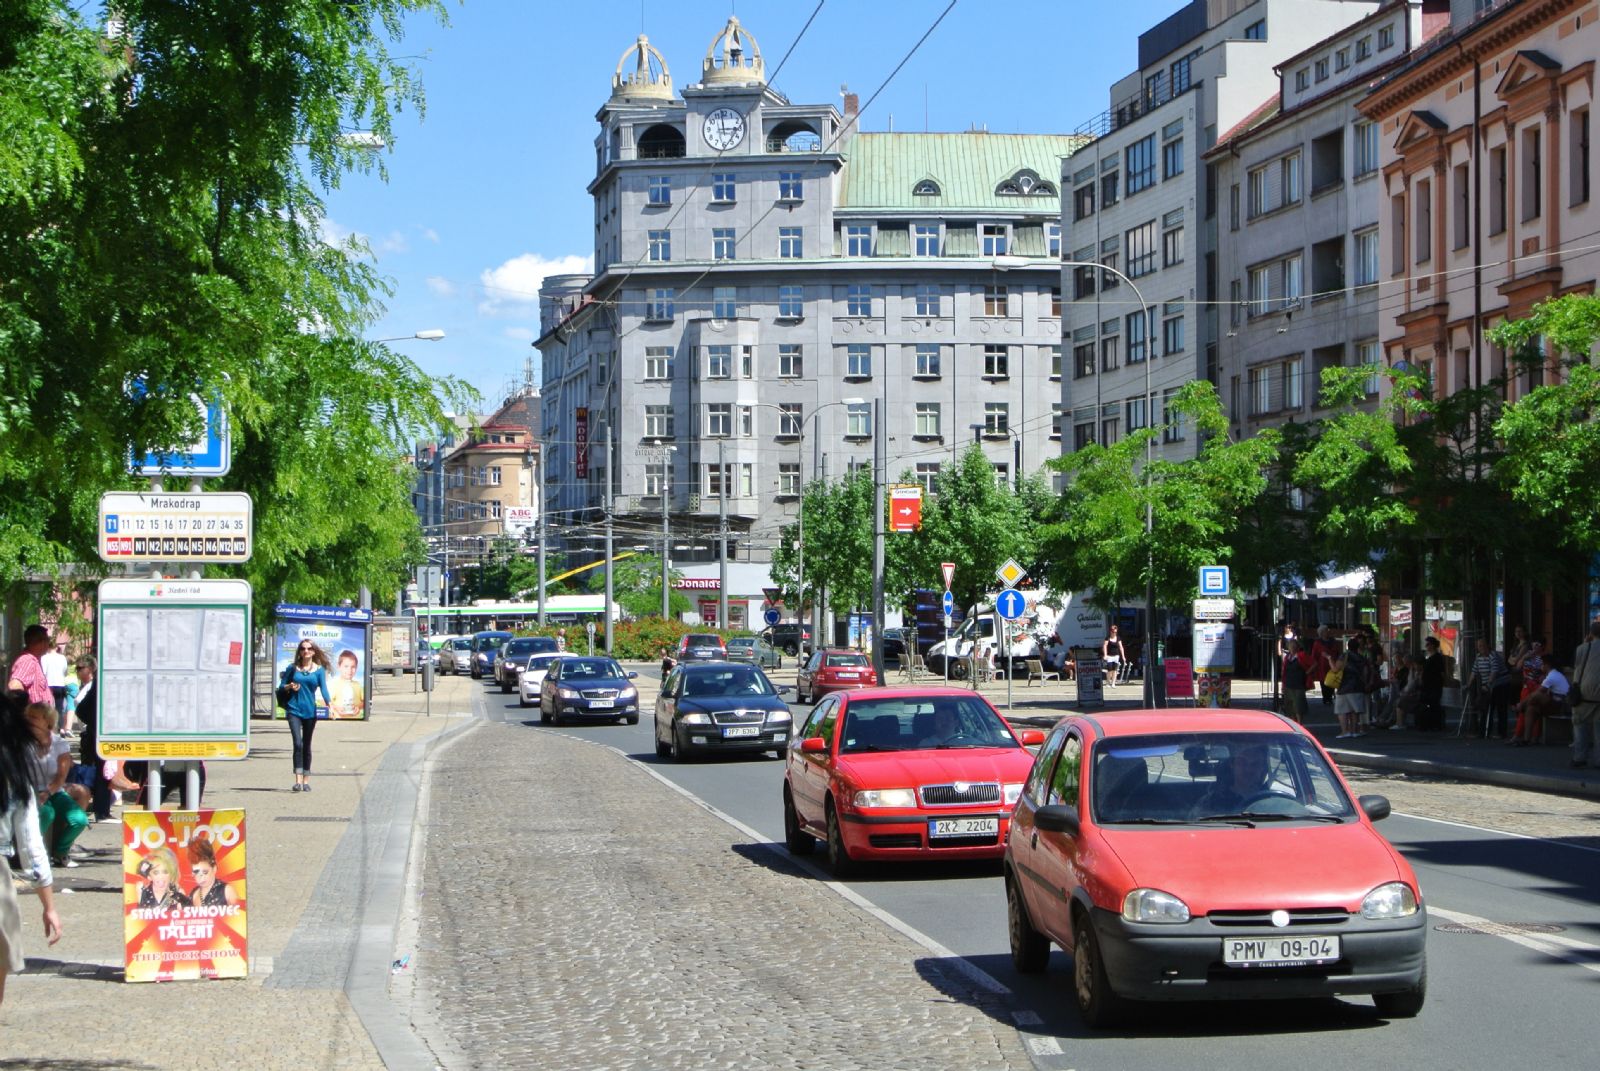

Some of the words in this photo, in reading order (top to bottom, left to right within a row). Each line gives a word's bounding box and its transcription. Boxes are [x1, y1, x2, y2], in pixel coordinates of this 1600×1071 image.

[151, 498, 201, 511] Mrakodrap
[107, 519, 117, 530] T1
[122, 519, 130, 530] 11
[136, 519, 145, 530] 12
[150, 519, 159, 530] 15
[164, 519, 173, 530] 16
[178, 519, 187, 530] 17
[192, 519, 202, 530] 20
[206, 519, 215, 530] 27
[220, 519, 230, 530] 34
[234, 519, 243, 530] 35
[135, 541, 145, 551] N1
[150, 541, 160, 551] N2
[164, 541, 173, 551] N3
[178, 541, 189, 551] N4
[191, 541, 203, 551] N5
[205, 541, 217, 551] N6
[110, 743, 131, 752] SMS
[939, 821, 958, 833] 2K2
[966, 820, 993, 832] 2204
[183, 904, 241, 918] SYNOVEC
[158, 919, 214, 940] TALENT
[132, 952, 161, 962] THE
[163, 950, 200, 962] ROCK
[200, 948, 241, 960] SHOW
[1233, 941, 1266, 960] PMV
[1280, 939, 1331, 958] 09-04
